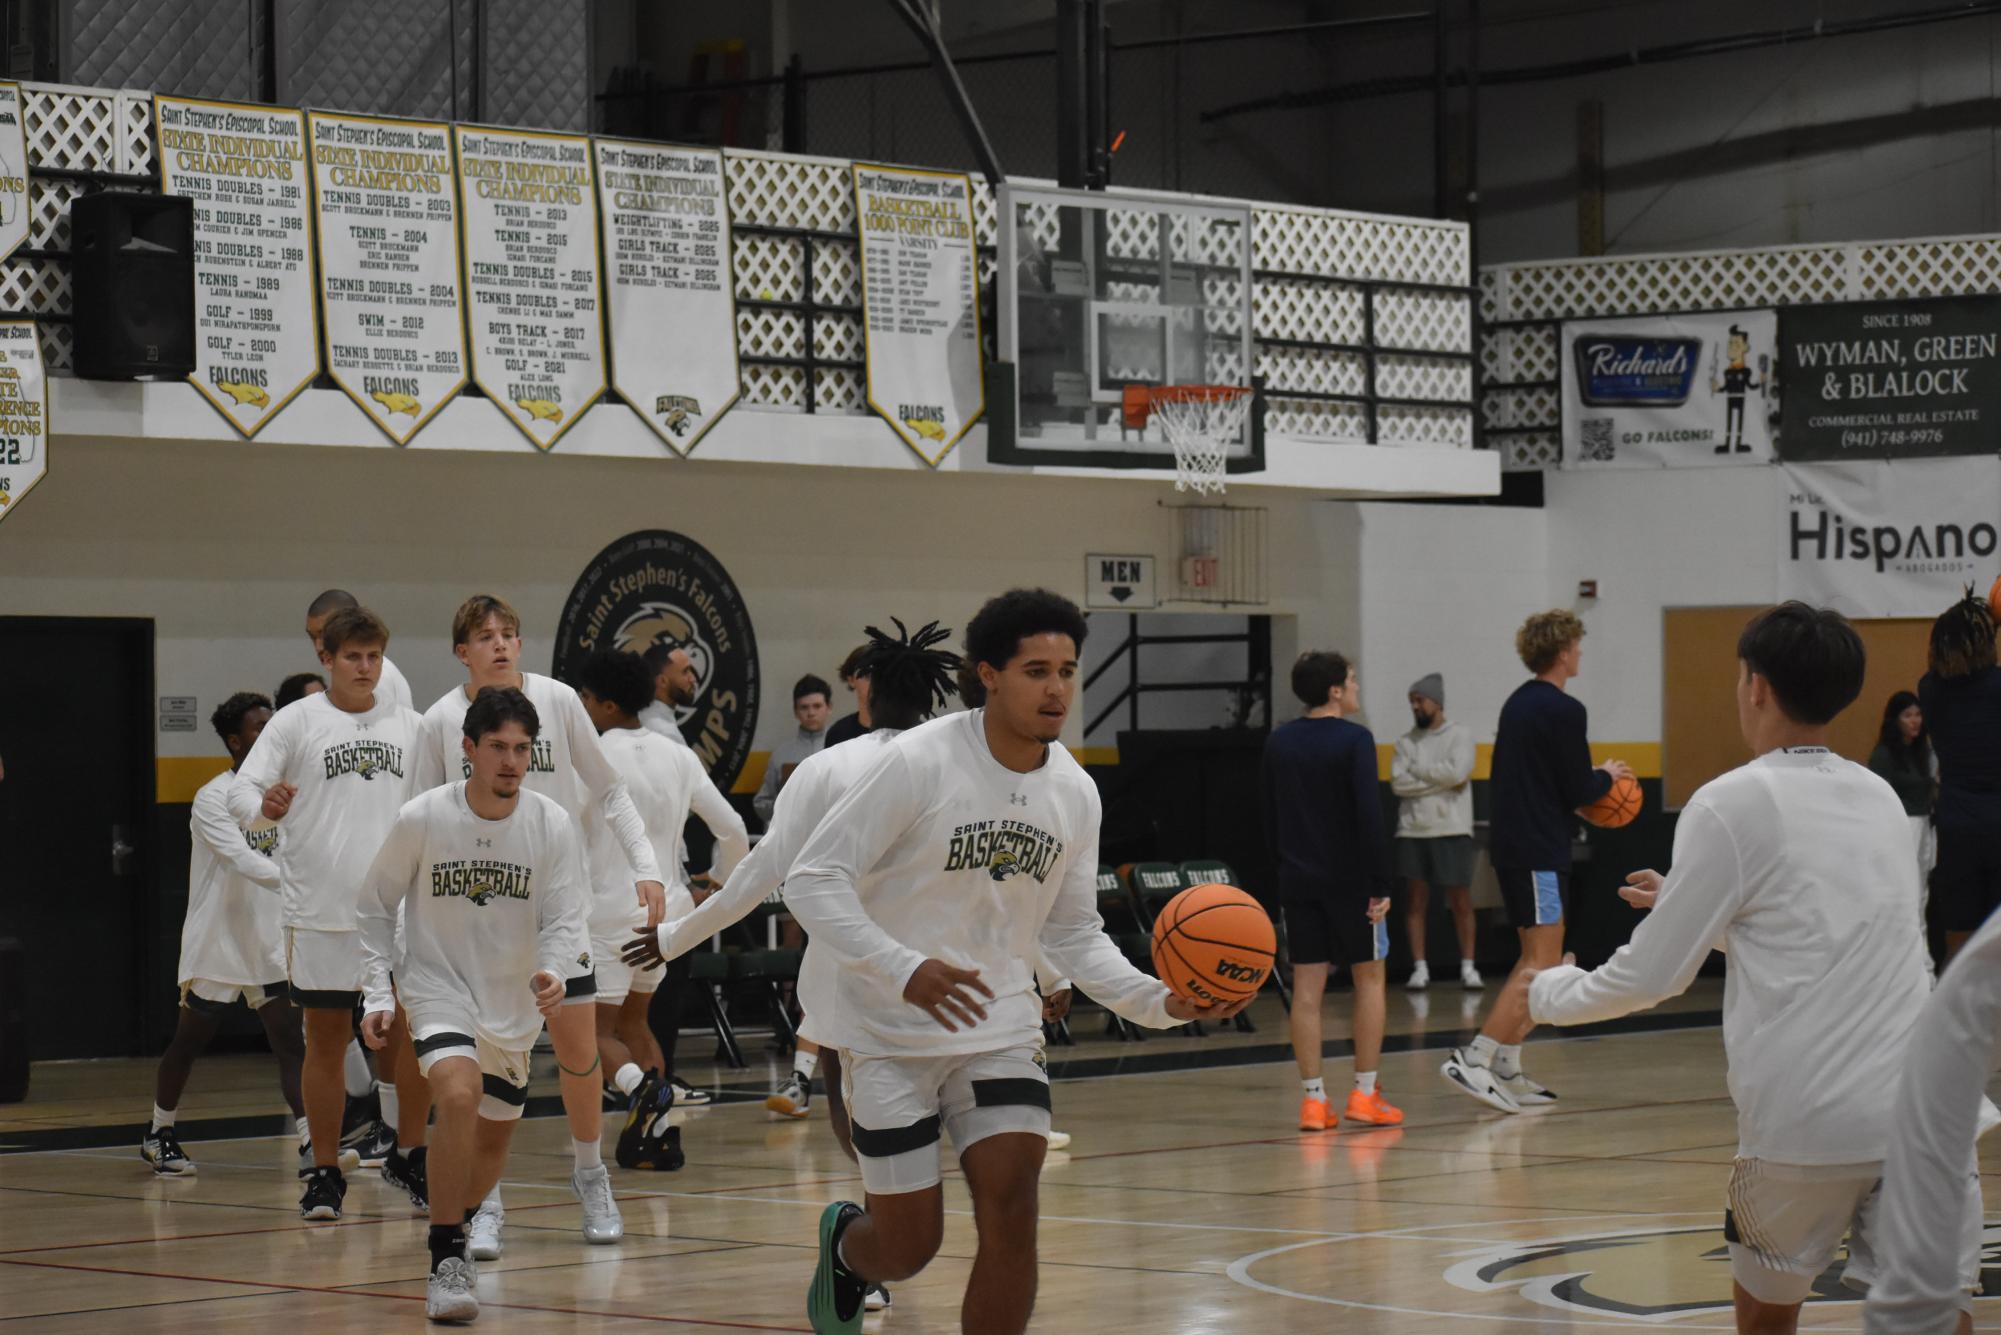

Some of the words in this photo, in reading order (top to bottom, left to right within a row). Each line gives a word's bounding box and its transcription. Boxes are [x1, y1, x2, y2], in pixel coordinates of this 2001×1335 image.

[162, 105, 182, 124] SAINT
[185, 108, 224, 131] STEPHEN'S
[226, 113, 265, 134] EPISCOPAL
[268, 117, 298, 136] SCHOOL
[163, 129, 206, 150] STATE
[208, 134, 303, 161] INDIVIDUAL
[315, 121, 335, 140] SAINT
[377, 128, 416, 149] EPISCOPAL
[418, 131, 446, 150] SCHOOL
[177, 152, 293, 181] CHAMPIONS
[316, 144, 358, 166] STATE
[359, 149, 450, 175] INDIVIDUAL
[172, 175, 212, 191] TENNIS
[218, 179, 263, 195] DOUBLES
[281, 185, 301, 199] 1981
[330, 167, 442, 194] CHAMPIONS
[323, 190, 361, 205] TENNIS
[367, 194, 410, 209] DOUBLES
[476, 180, 582, 205] CHAMPIONS
[193, 209, 211, 222] NIS
[217, 211, 262, 227] DOUBLES
[494, 204, 530, 217] TENNIS
[349, 226, 386, 240] TENNIS
[404, 230, 427, 243] 2004
[495, 230, 530, 243] TENNIS
[936, 220, 969, 239] CLUB
[194, 241, 212, 254] NIS
[217, 243, 263, 258] DOUBLES
[618, 239, 646, 252] GIRLS
[649, 241, 679, 254] TRACK
[473, 262, 509, 277] TENNIS
[514, 266, 555, 280] DOUBLES
[619, 264, 647, 277] GIRLS
[651, 266, 679, 279] TRACK
[199, 272, 238, 288] TENNIS
[256, 277, 280, 290] 1989
[328, 277, 364, 292] TENNIS
[369, 280, 412, 295] DOUBLES
[430, 284, 454, 298] 2004
[476, 291, 511, 305] TENNIS
[516, 294, 558, 308] DOUBLES
[207, 304, 231, 319] GOLF
[358, 313, 384, 327] SWIM
[402, 316, 424, 329] 2012
[489, 322, 512, 335] BOYS
[516, 324, 547, 338] TRACK
[1863, 315, 1899, 329] SINCE
[208, 336, 232, 350] GOLF
[251, 340, 276, 353] 2000
[1795, 339, 1907, 368] WYMAN,
[1914, 333, 1997, 362] GREEN
[333, 345, 369, 359] TENNIS
[374, 348, 418, 362] DOUBLES
[435, 351, 458, 364] 2013
[506, 359, 528, 371] GOLF
[209, 366, 268, 387] FALCONS
[363, 376, 419, 396] FALCONS
[1821, 372, 1842, 400] &
[1849, 368, 1969, 400] BLALOCK
[508, 384, 562, 402] FALCONS
[899, 405, 945, 423] FALCONS
[1809, 413, 1894, 428] COMMERCIAL
[1897, 411, 1928, 425] REAL
[1932, 409, 1980, 423] ESTATE
[1622, 431, 1643, 444] GO
[1647, 429, 1714, 443] FALCONS!
[1841, 429, 1877, 448] (941)
[1101, 561, 1141, 583] MEN
[579, 594, 614, 650] Saint
[610, 561, 687, 602] Stephen's
[688, 579, 732, 653] Falcons
[324, 742, 351, 756] SAINT
[355, 740, 403, 755] STEPHEN'S
[324, 747, 404, 780] BASKETBALL
[954, 820, 996, 837] SAINT
[1001, 819, 1063, 854] STEPHEN'S
[944, 830, 1058, 885] BASKETBALL
[432, 860, 467, 871] SAINT
[472, 860, 532, 876] STEPHEN'S
[432, 868, 530, 900] BASKETBALL
[1141, 871, 1180, 889] FALCONS
